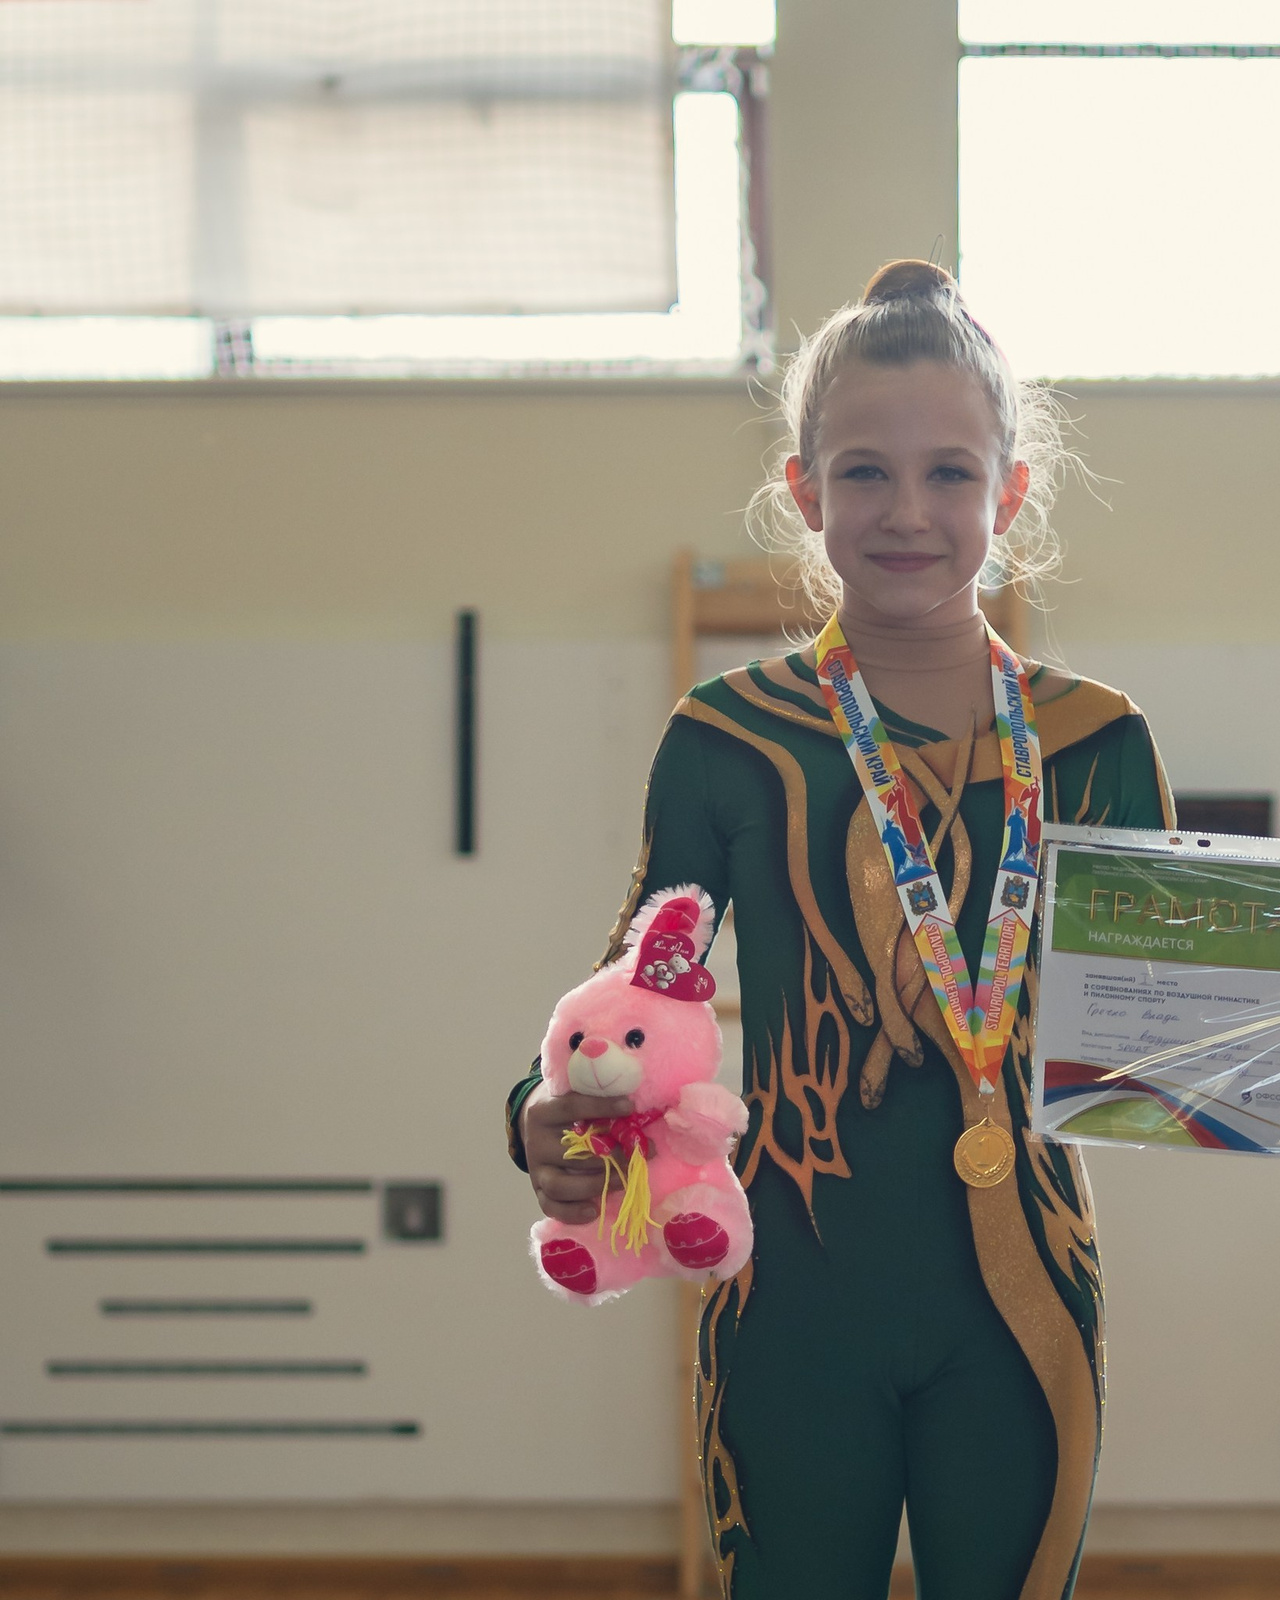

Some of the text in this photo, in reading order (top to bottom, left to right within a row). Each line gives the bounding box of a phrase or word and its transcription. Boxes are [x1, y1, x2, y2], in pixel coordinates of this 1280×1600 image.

[827, 659, 896, 788] СТАВРОПОЛЬСКИЙ КРАЙ
[1001, 678, 1032, 778] СТАВРОПОЛЬСКИЙ
[1088, 930, 1194, 951] НАГРАЖДАЕТСЯ
[925, 922, 969, 1032] STAVROPOL TERRITORY
[985, 916, 1018, 1031] STAVROPOL TERRITORY
[1090, 983, 1152, 995] СОРЕВНОВАНИЯХ
[1153, 989, 1165, 997] ПО
[1166, 991, 1212, 1000] ВОЗДУШНОЙ
[1213, 995, 1260, 1005] ГИМНАСТИКЕ
[1090, 991, 1136, 1001] ПИЛОННОМУ
[1137, 996, 1166, 1004] СПОРТУ
[1156, 979, 1179, 987] место
